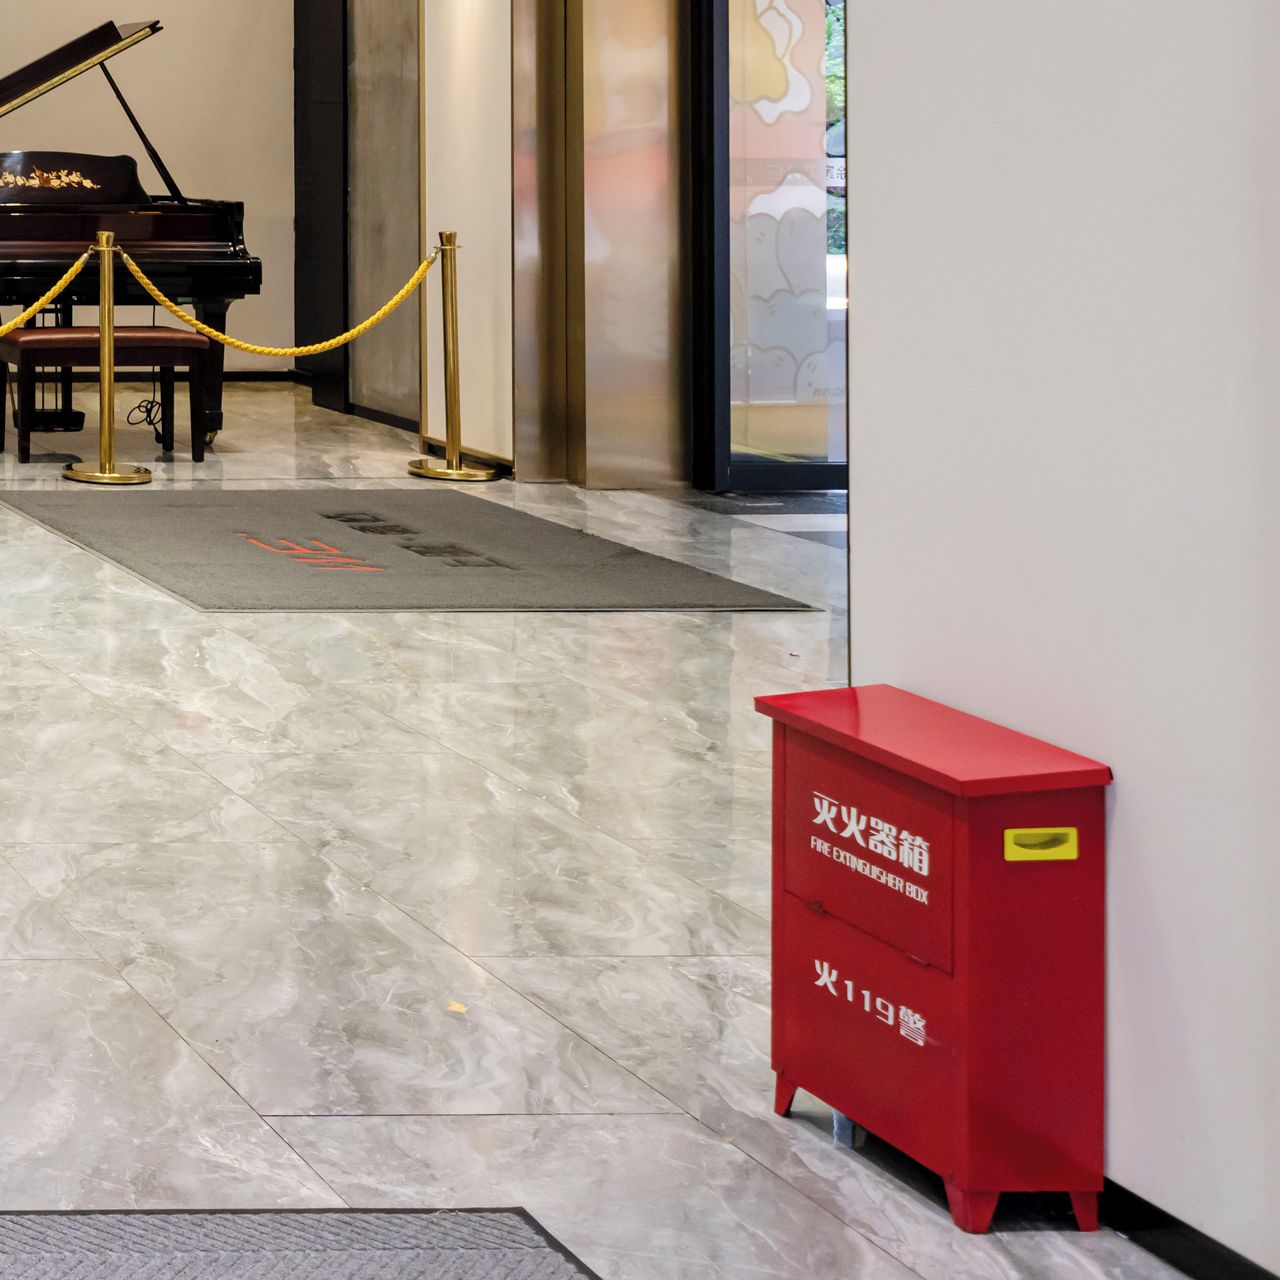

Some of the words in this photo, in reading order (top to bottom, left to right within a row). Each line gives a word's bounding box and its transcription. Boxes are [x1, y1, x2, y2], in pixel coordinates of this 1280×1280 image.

[810, 835, 831, 858] FIRE
[833, 846, 904, 894] EXTINGUISHER
[905, 883, 930, 905] BOX
[812, 791, 930, 877] 灭火器箱
[814, 958, 927, 1047] 火119警
